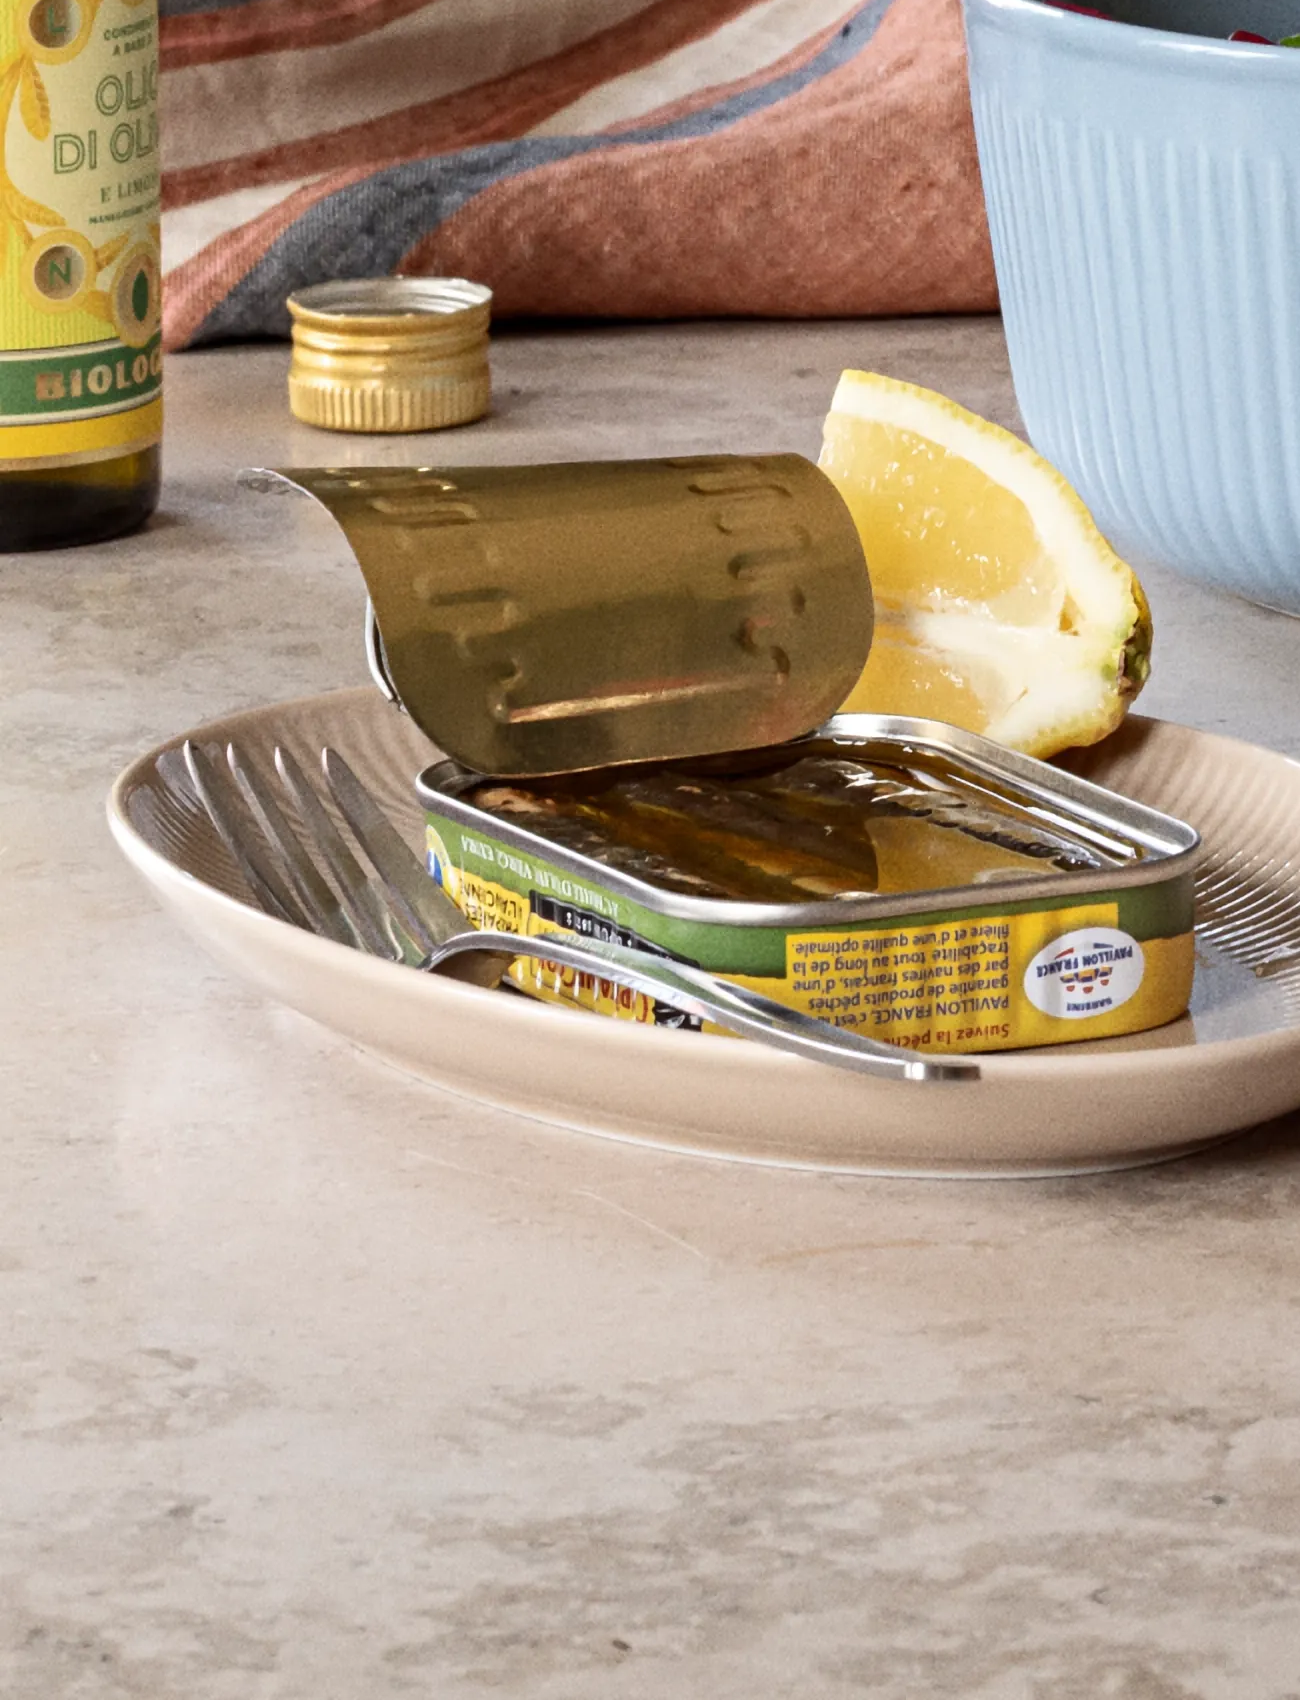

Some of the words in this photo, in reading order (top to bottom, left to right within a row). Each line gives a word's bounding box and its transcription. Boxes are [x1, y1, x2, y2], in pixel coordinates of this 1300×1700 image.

[53, 129, 97, 174] DI
[49, 257, 71, 286] N
[912, 931, 951, 946] d'une
[954, 929, 967, 942] et
[970, 924, 1010, 940] filière
[791, 937, 859, 958] optimale.
[871, 955, 890, 968] au
[893, 951, 926, 967] tout
[985, 956, 1009, 972] par
[1082, 945, 1133, 967] PAVILLON
[792, 962, 806, 977] la
[810, 961, 831, 976] de
[834, 956, 868, 976] long
[901, 966, 953, 982] navires
[957, 961, 981, 977] des
[1036, 957, 1079, 978] FRANCE
[792, 978, 836, 994] d'une
[927, 984, 945, 998] de
[949, 974, 1009, 996] garantie
[864, 984, 925, 1005] produits
[935, 995, 1009, 1016] PAVILLON
[936, 1030, 951, 1044] la
[955, 1024, 1010, 1040] Suivez
